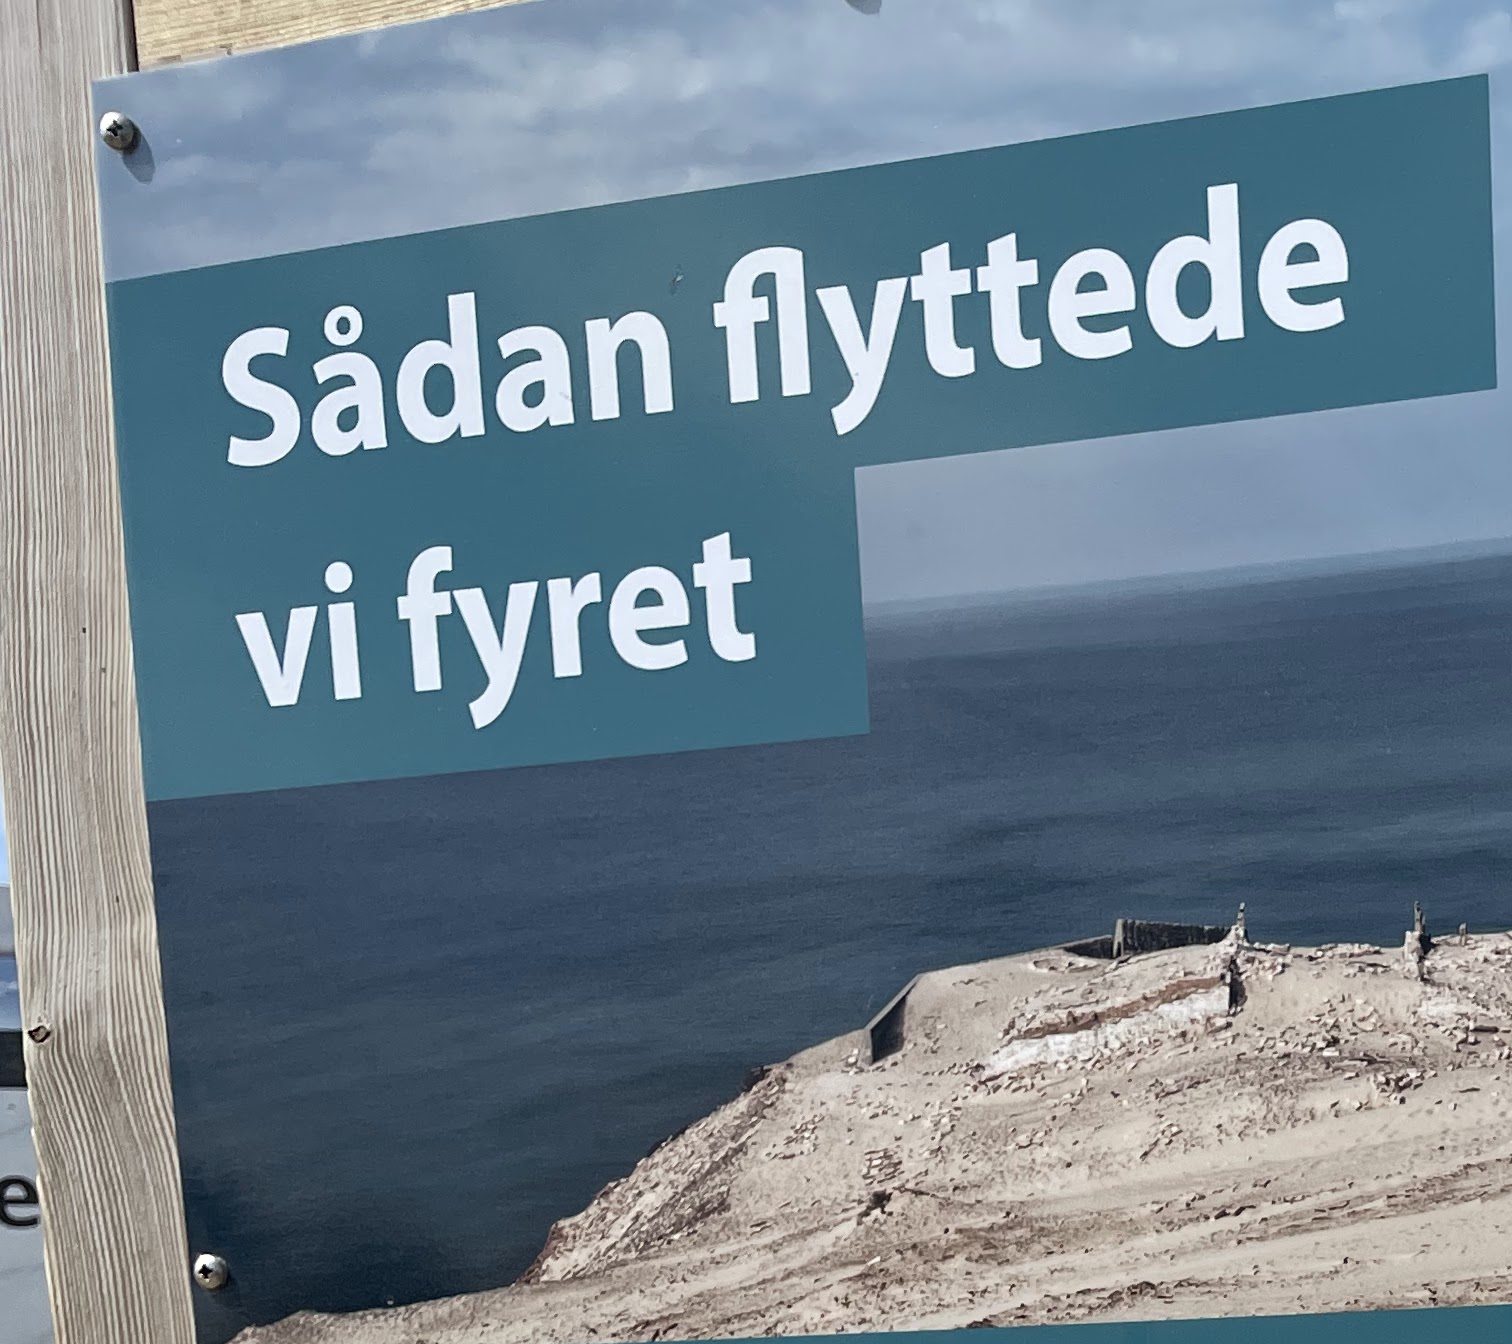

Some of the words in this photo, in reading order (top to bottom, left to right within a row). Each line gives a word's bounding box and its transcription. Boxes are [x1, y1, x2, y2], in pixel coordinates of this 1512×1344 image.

[222, 291, 674, 467] Sådan
[712, 182, 1350, 436] flyttede
[234, 561, 362, 707] vi
[396, 531, 756, 730] fyret
